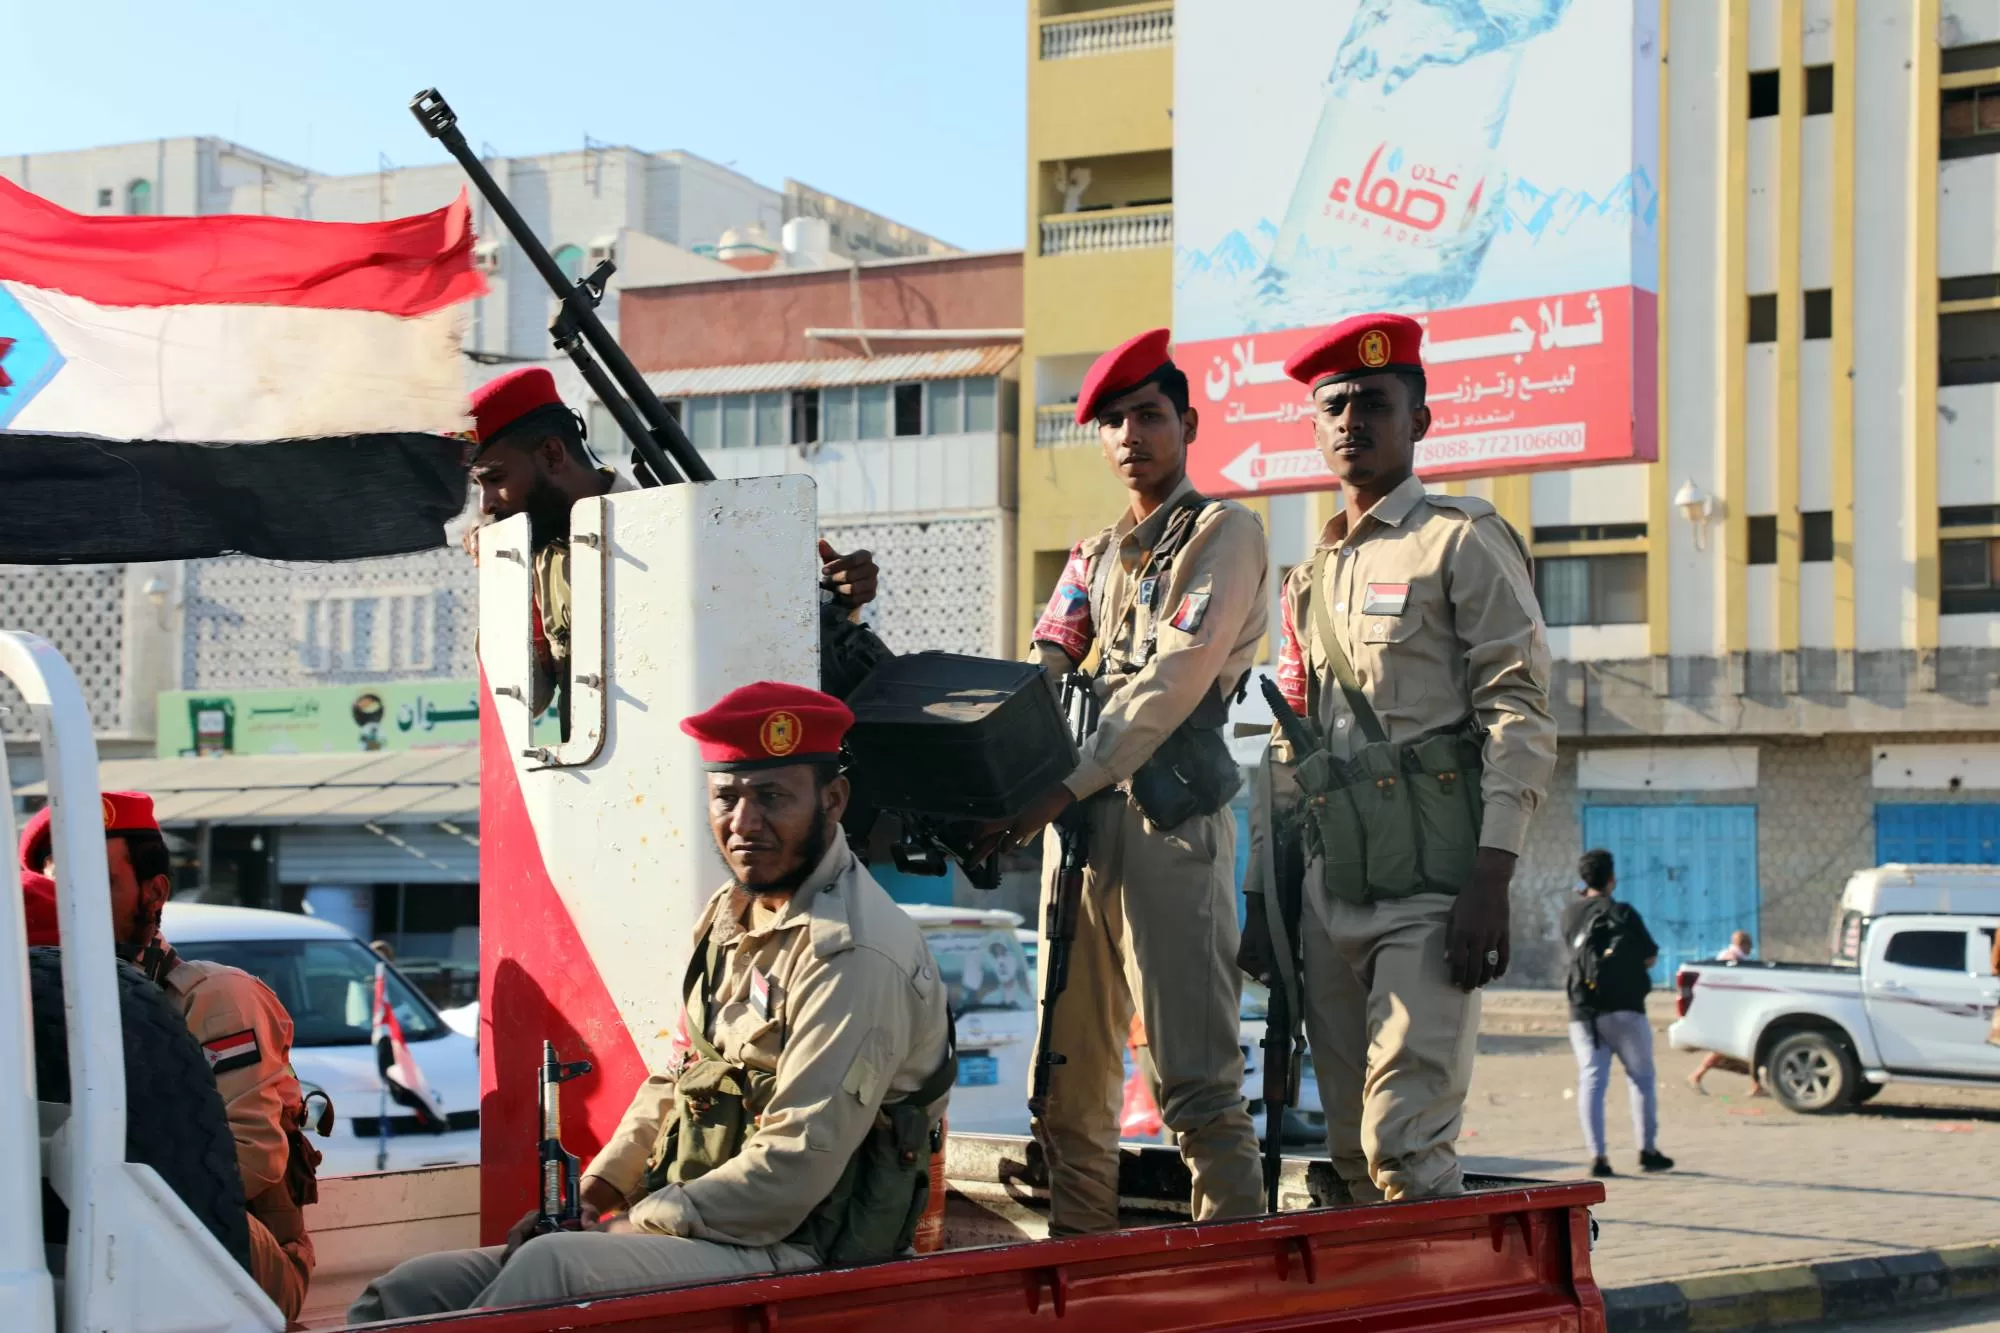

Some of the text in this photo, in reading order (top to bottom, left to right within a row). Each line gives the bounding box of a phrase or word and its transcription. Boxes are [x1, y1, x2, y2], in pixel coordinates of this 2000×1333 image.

[1328, 140, 1445, 232] صفاء
[1411, 163, 1461, 190] عدن
[1322, 203, 1371, 230] SAFA
[1425, 371, 1515, 404] وتوزي
[1518, 364, 1577, 401] لبيع
